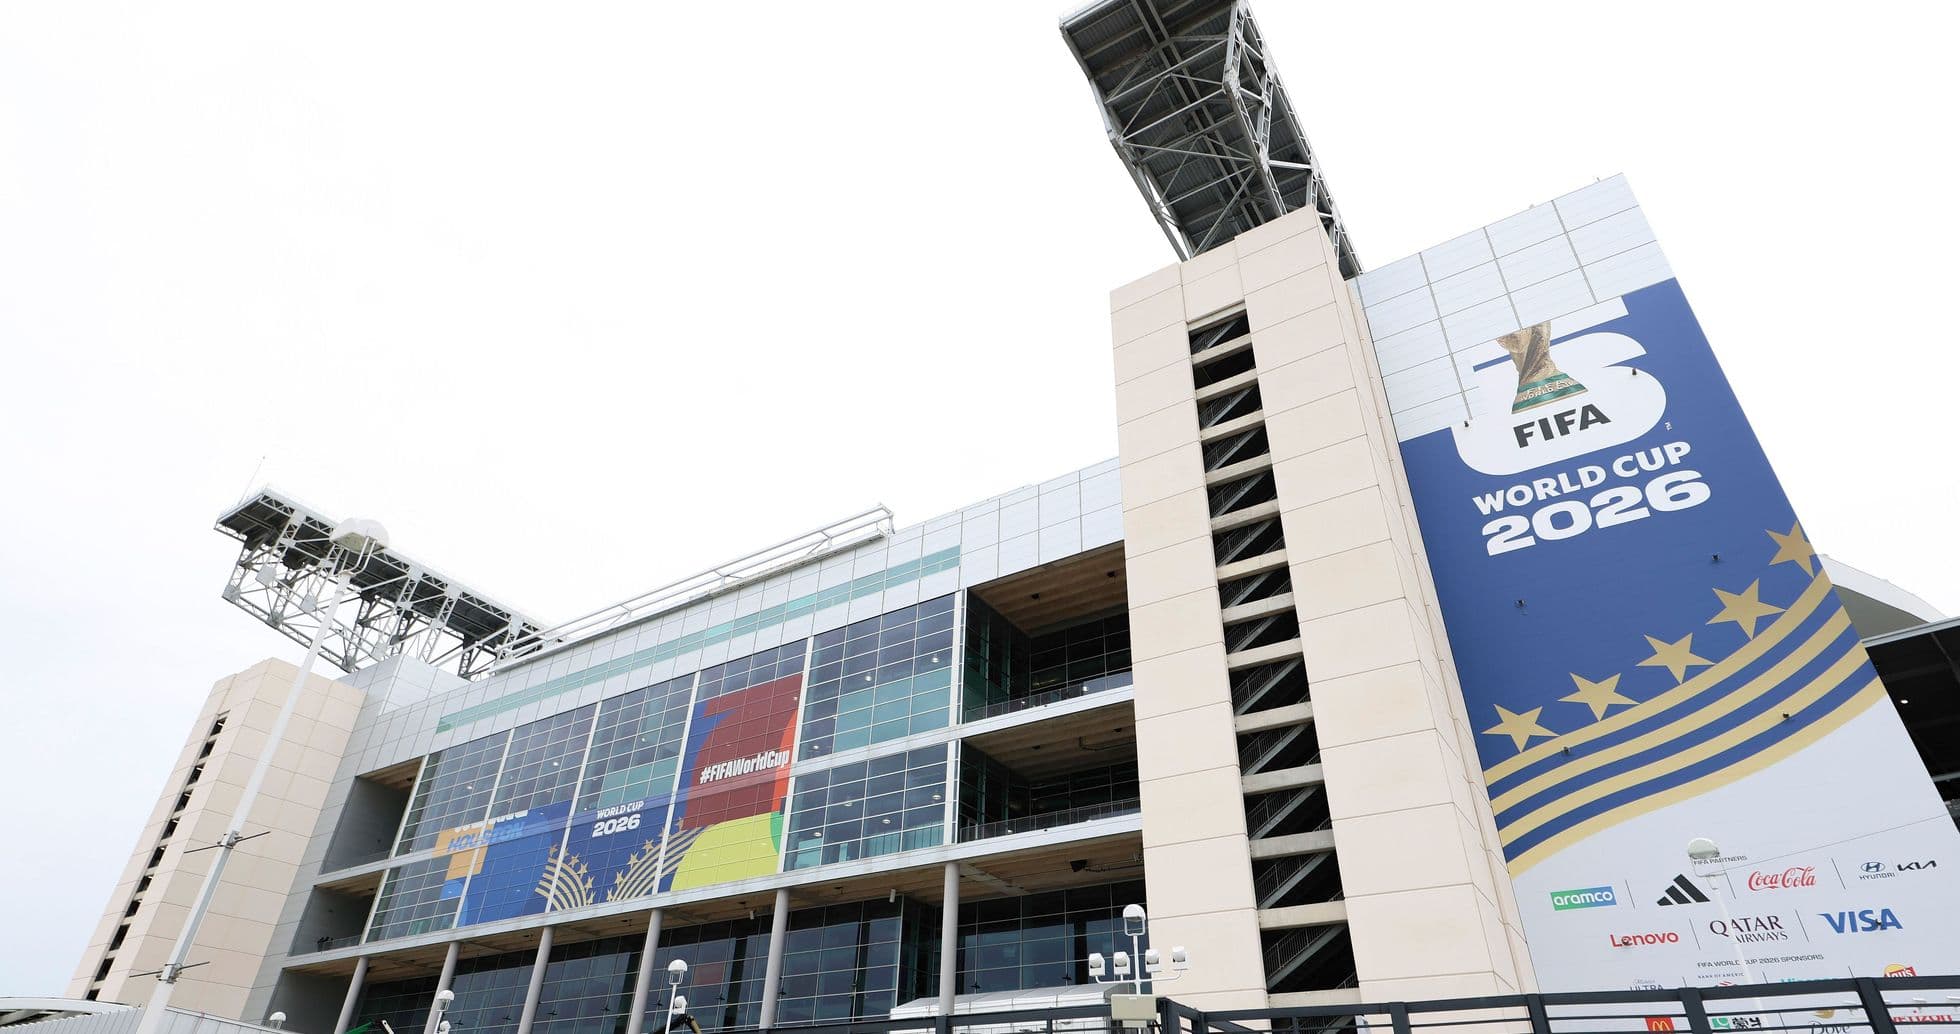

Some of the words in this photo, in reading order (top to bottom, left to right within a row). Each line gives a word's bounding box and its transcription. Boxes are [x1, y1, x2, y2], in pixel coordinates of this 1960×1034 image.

[1513, 403, 1611, 448] FIFA
[1472, 465, 1607, 516] WORLD
[1612, 441, 1691, 478] CUP
[1481, 470, 1712, 556] 2026
[700, 750, 790, 785] #FIFAWorldCup
[596, 804, 626, 820] WORLD
[626, 800, 645, 813] CUP
[592, 813, 641, 838] 2026
[1858, 872, 1896, 880] HYUNDAI
[1553, 891, 1613, 906] aramco
[1709, 915, 1784, 938] QATAR
[1816, 908, 1903, 934] VISA
[1609, 932, 1679, 948] Lenovo
[1735, 930, 1788, 943] AIRWAYS
